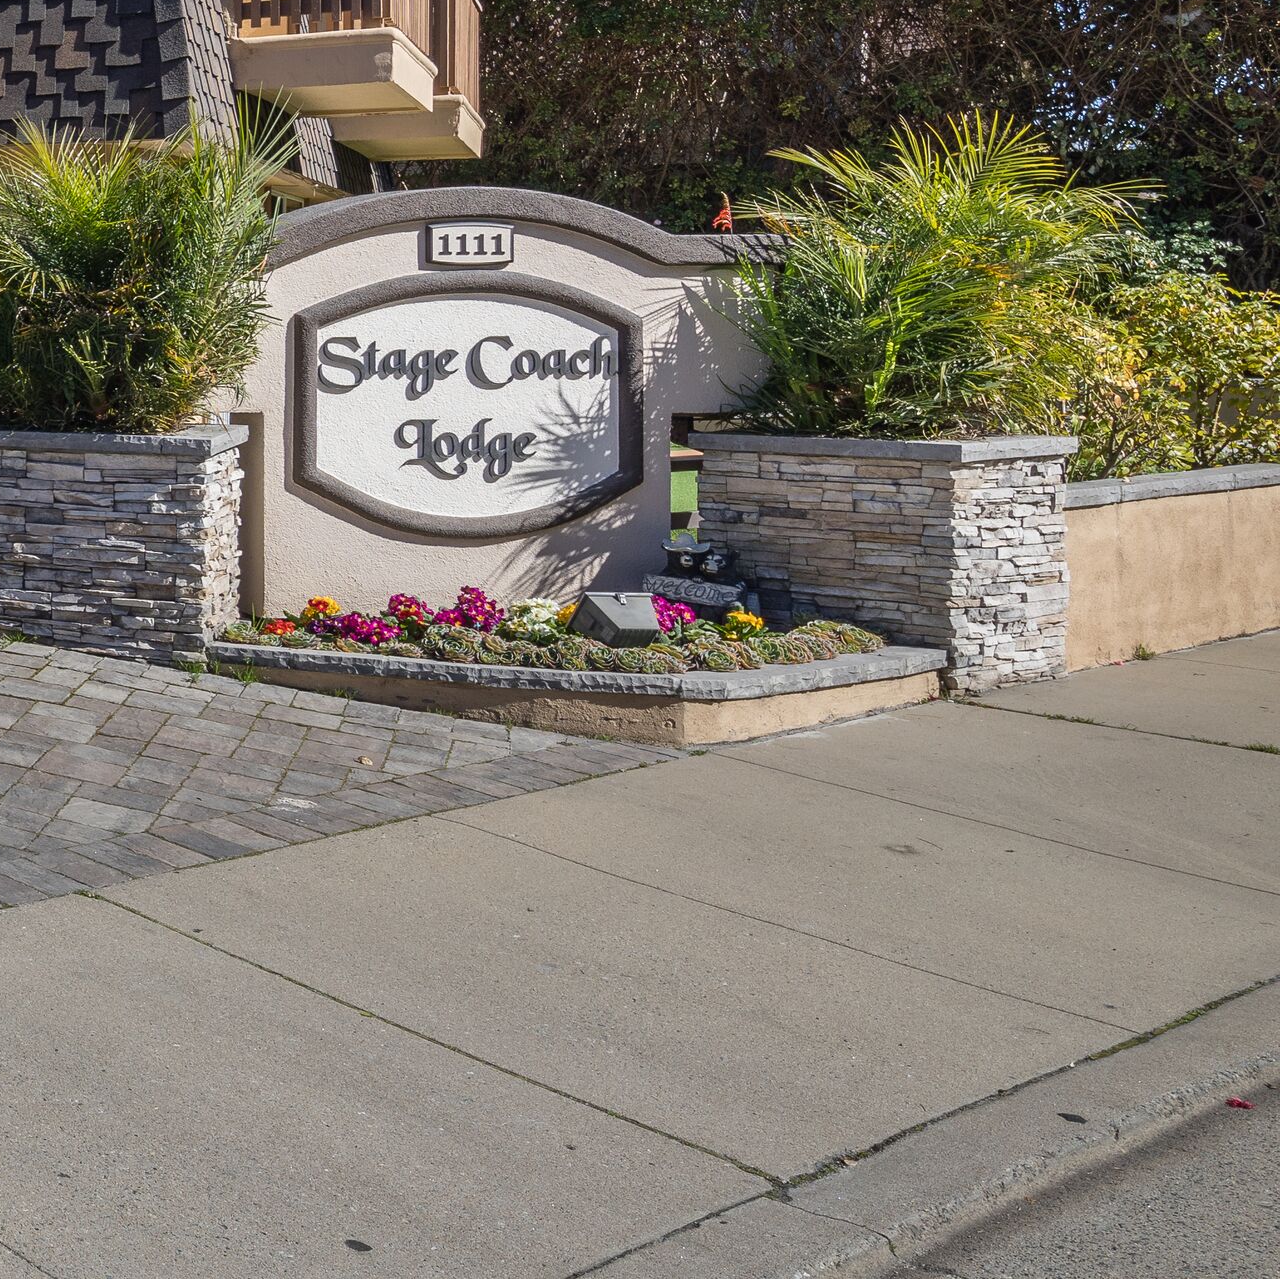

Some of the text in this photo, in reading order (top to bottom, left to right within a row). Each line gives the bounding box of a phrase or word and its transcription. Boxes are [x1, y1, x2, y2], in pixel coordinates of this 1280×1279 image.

[438, 233, 506, 256] 1111
[317, 335, 619, 401] Stage Coach
[393, 418, 537, 483] Lodge
